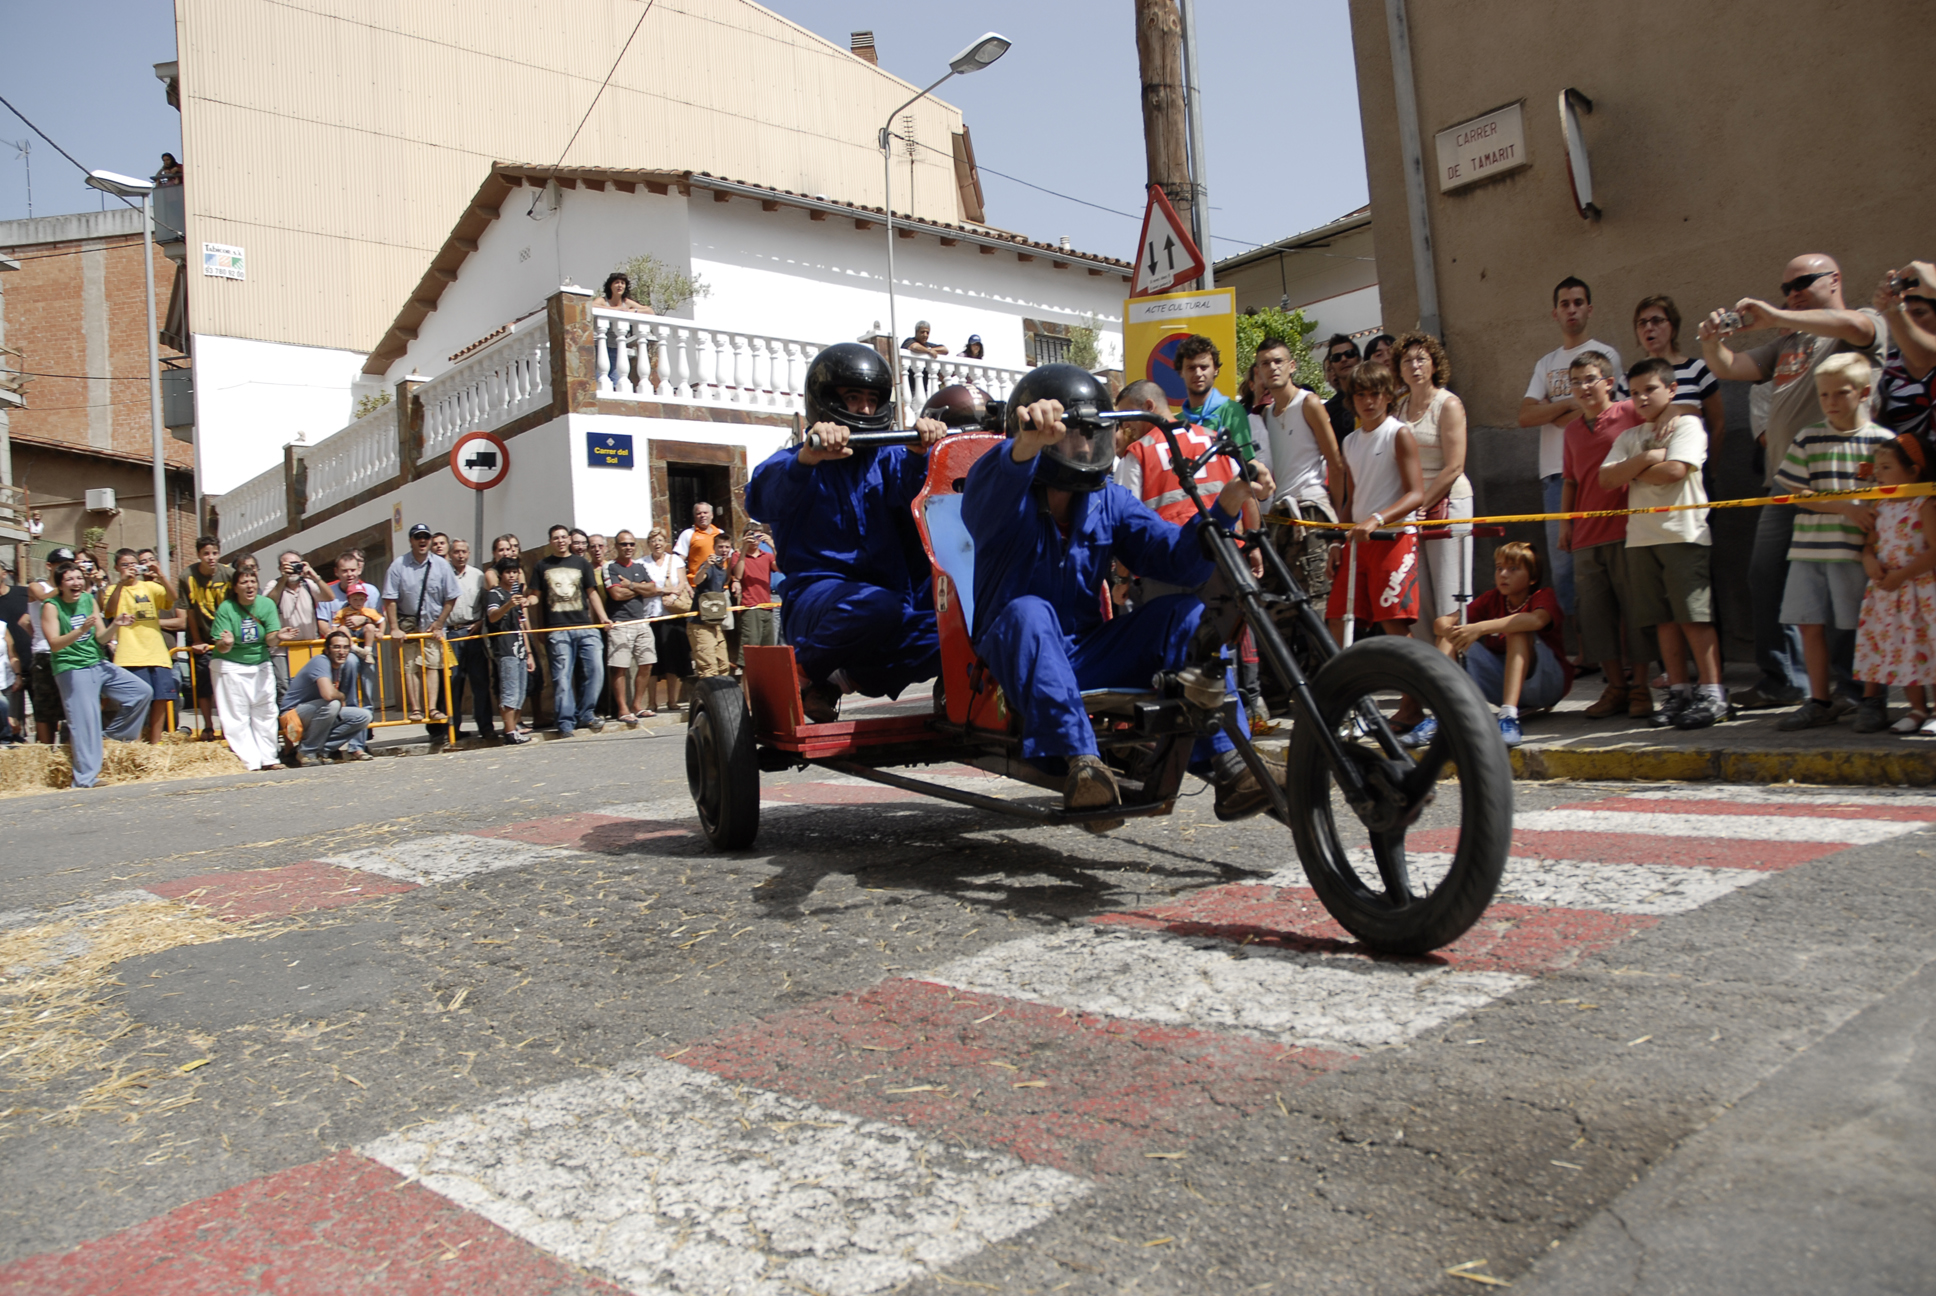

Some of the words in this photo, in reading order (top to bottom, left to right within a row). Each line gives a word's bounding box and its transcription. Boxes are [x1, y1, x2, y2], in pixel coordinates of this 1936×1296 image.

[1456, 121, 1497, 147] CARRER
[1447, 163, 1461, 180] DE
[1470, 144, 1515, 171] TAMARIT
[1144, 304, 1167, 314] ACTE
[593, 446, 617, 455] Carrer
[617, 448, 629, 456] del
[605, 456, 618, 464] Sol
